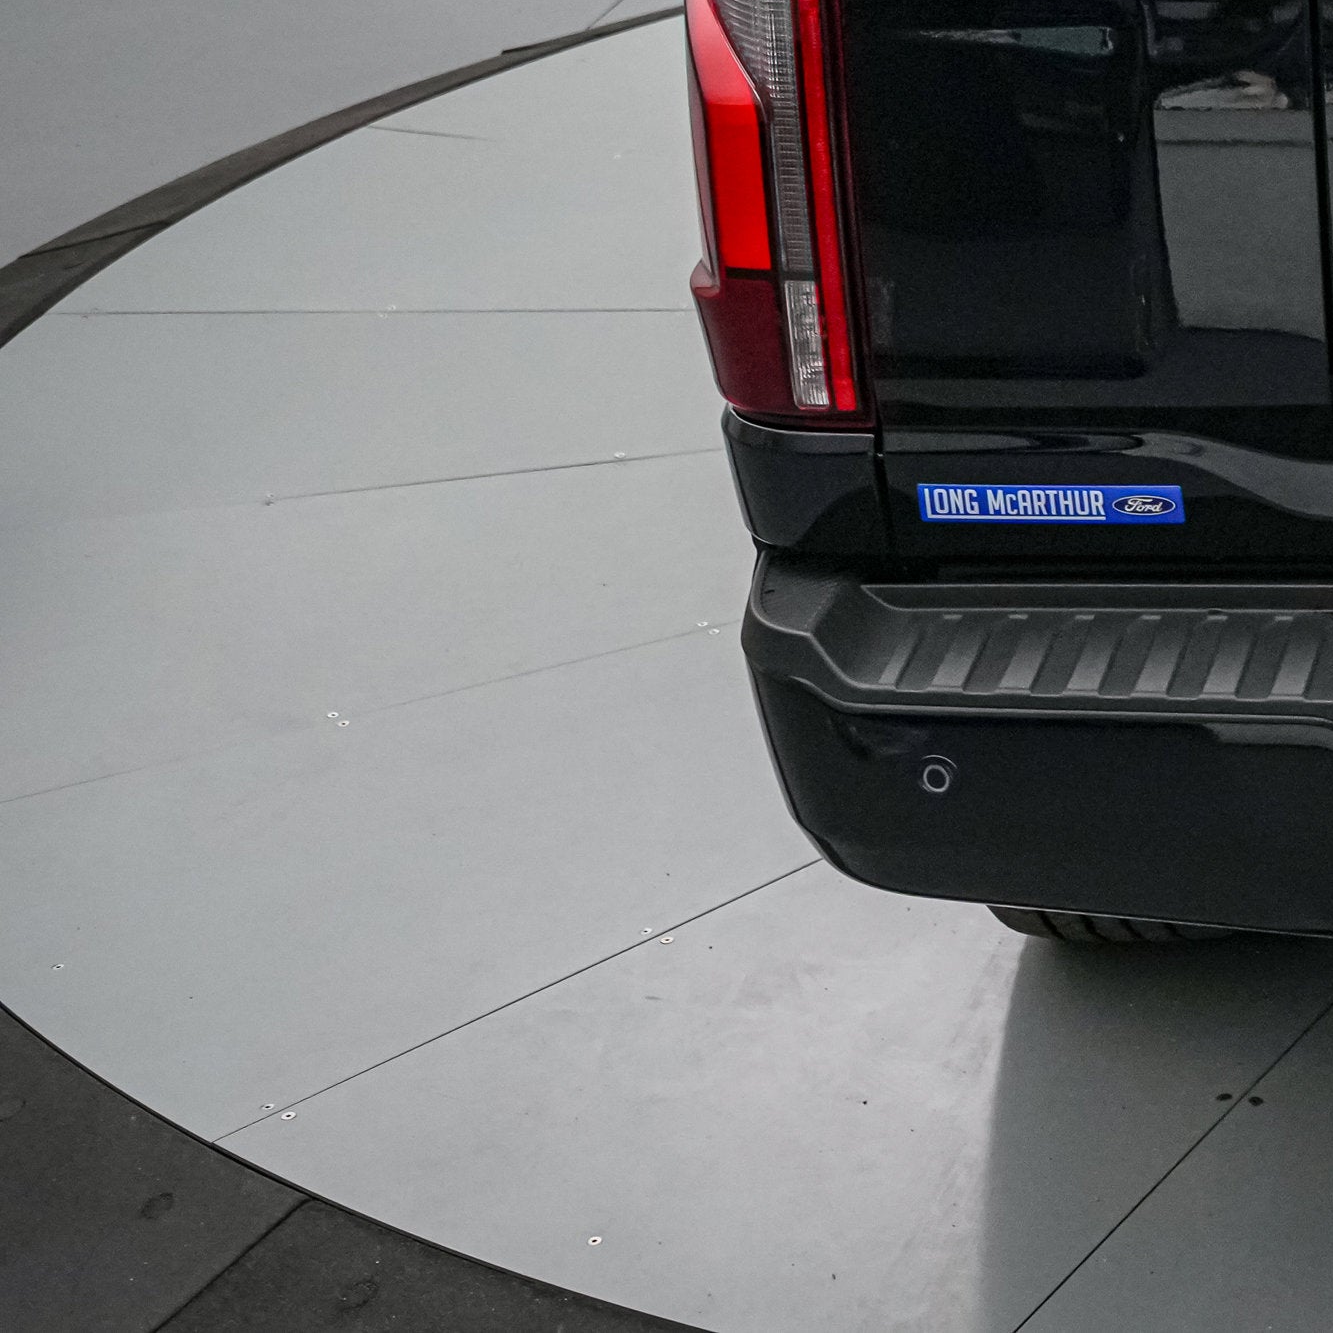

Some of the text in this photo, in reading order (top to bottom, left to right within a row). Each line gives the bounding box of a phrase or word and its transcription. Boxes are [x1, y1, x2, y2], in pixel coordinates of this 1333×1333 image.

[924, 488, 1163, 519] LONG McARTHUR Ford
